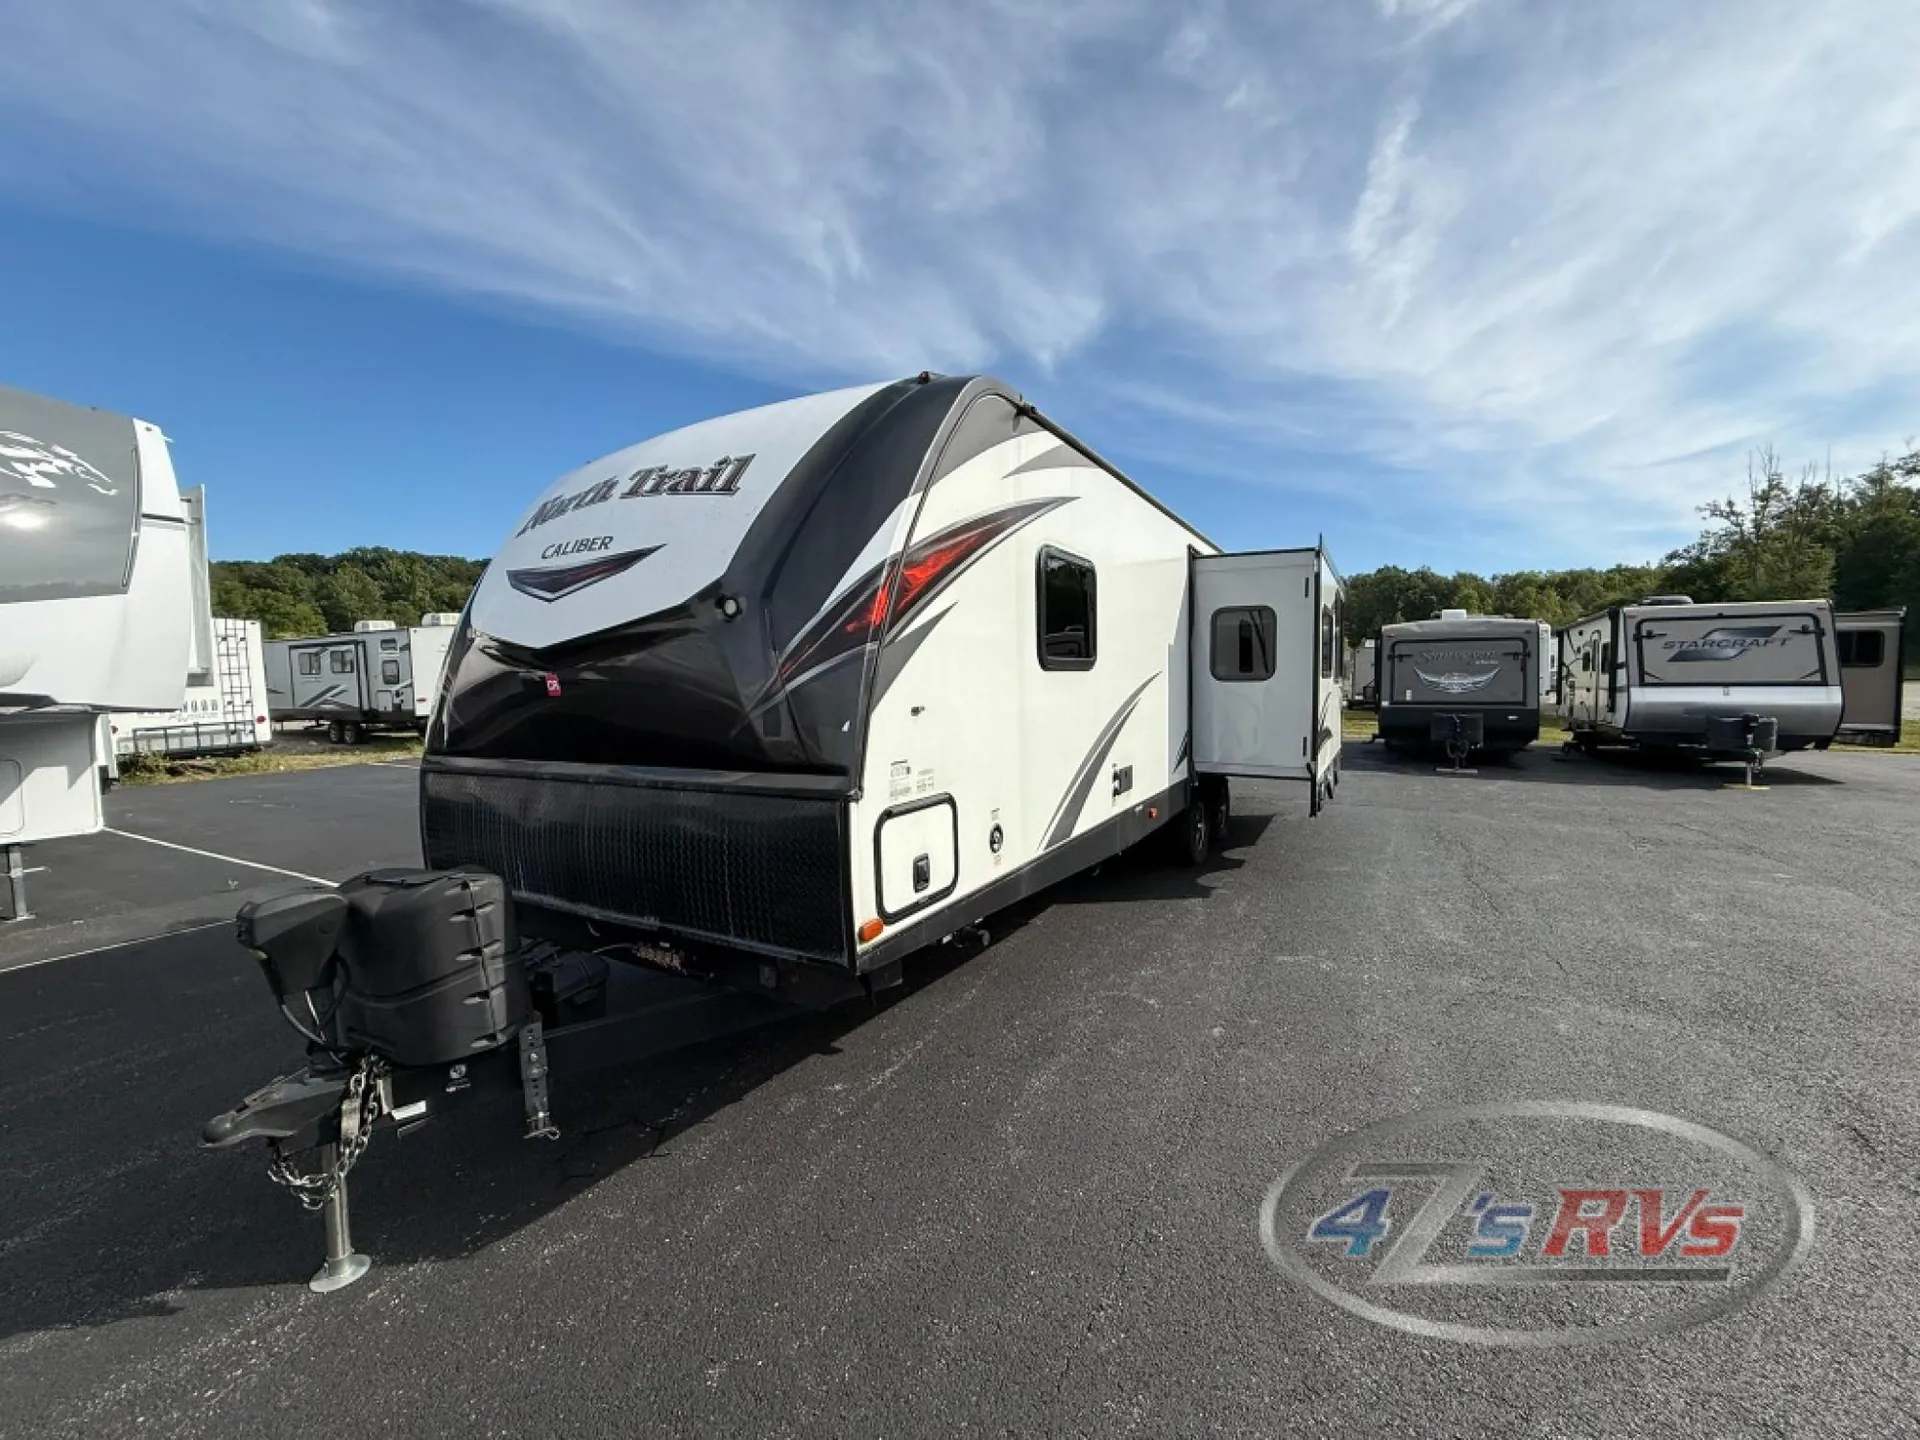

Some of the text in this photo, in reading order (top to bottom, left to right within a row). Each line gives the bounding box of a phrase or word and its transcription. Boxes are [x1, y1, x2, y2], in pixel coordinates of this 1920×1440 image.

[514, 453, 756, 539] North Trail
[541, 535, 614, 560] CALIBER
[1661, 637, 1791, 650] STARCRAFT
